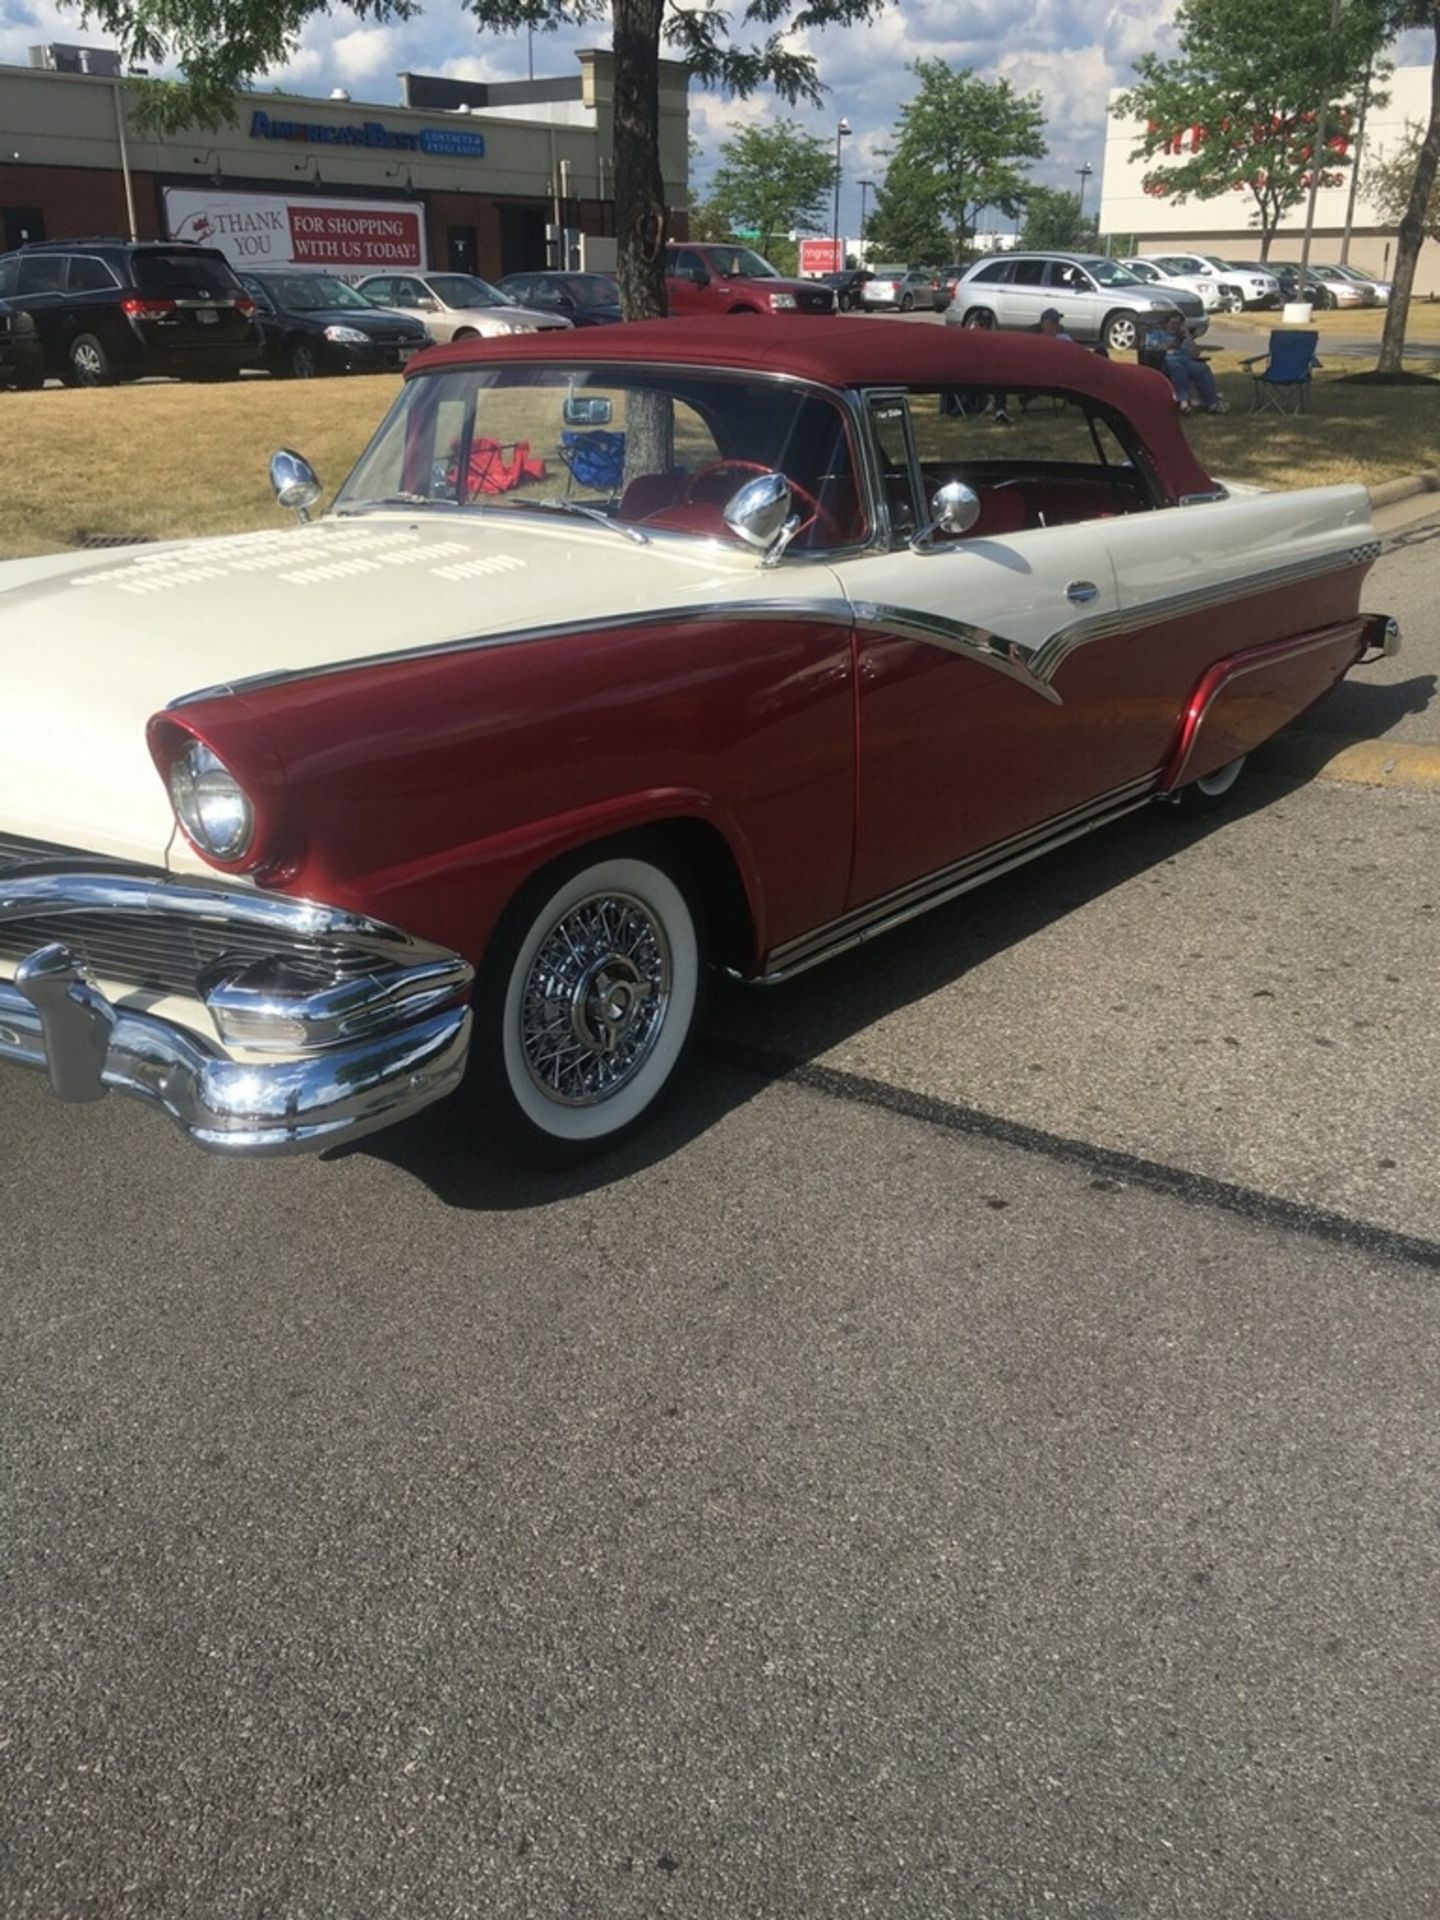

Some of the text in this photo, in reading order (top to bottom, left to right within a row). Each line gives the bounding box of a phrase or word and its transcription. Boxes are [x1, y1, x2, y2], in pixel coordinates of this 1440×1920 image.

[214, 211, 284, 234] THANK
[293, 215, 404, 236] FOR SHOPPING
[233, 236, 272, 257] YOU
[295, 240, 417, 259] WITH US TODAY!
